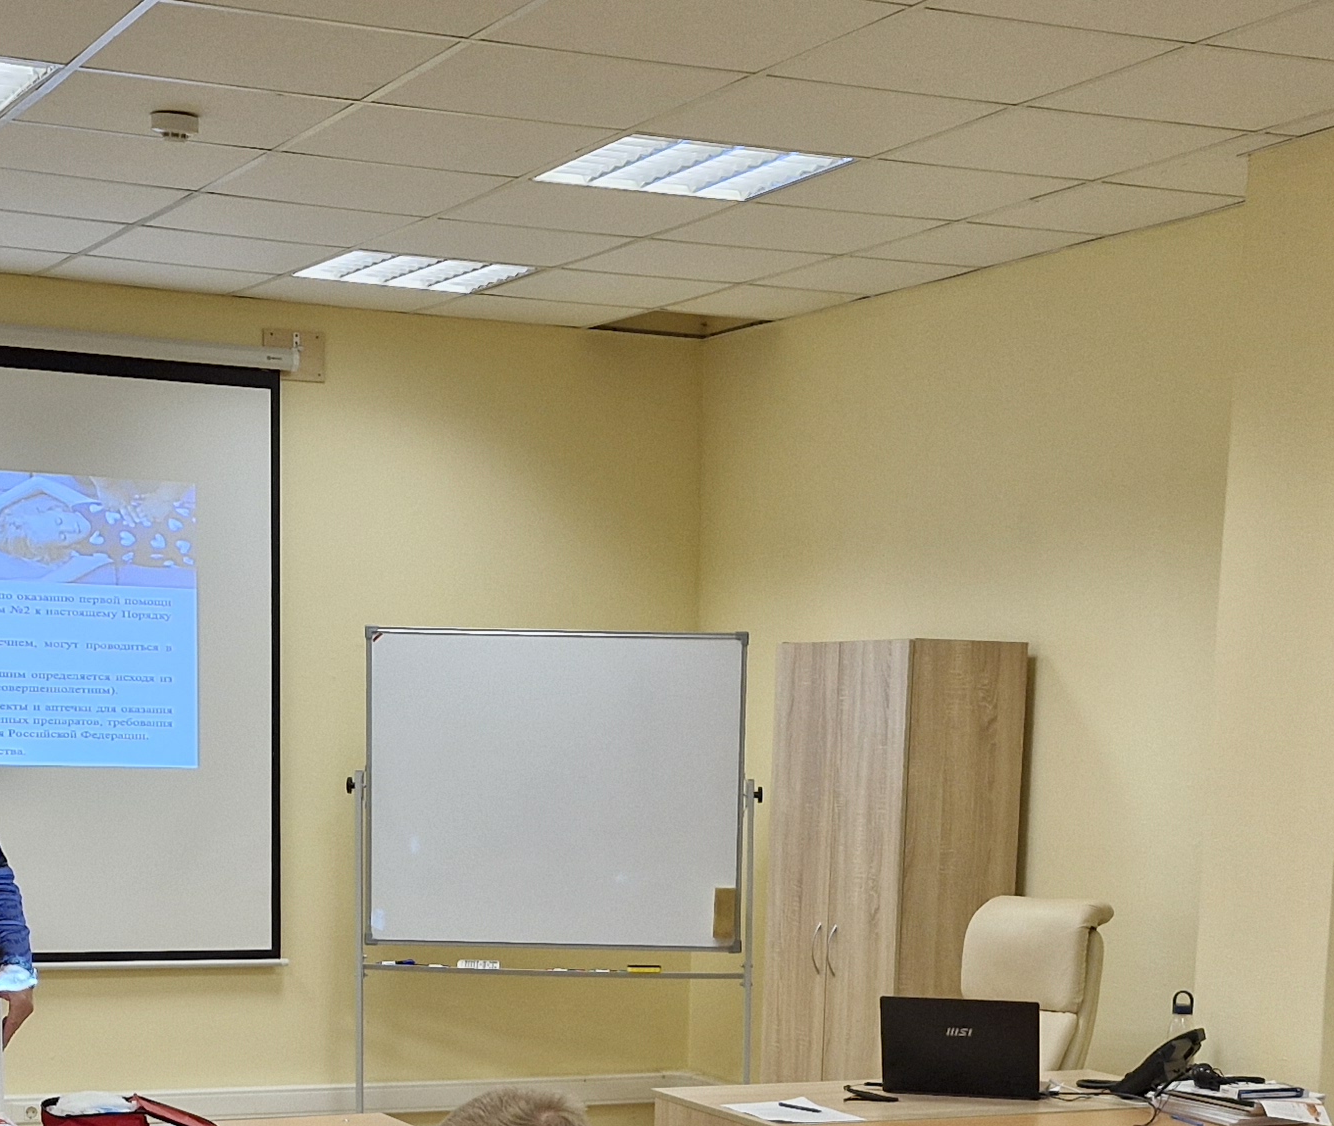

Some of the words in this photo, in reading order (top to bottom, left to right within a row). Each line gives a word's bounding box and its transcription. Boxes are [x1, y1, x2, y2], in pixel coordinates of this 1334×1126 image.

[16, 593, 75, 603] оказанию
[79, 595, 120, 606] первой
[124, 598, 172, 607] помощи
[46, 608, 117, 620] настоящему
[122, 609, 172, 622] Порядку
[43, 641, 79, 651] могут
[86, 642, 159, 652] проводиться
[31, 672, 111, 682] определяется
[115, 674, 155, 682] исходя
[45, 704, 92, 712] аптечки
[121, 706, 173, 714] оказания
[107, 718, 173, 728] требования
[8, 729, 77, 739] Российской
[81, 730, 149, 741] Федерации.
